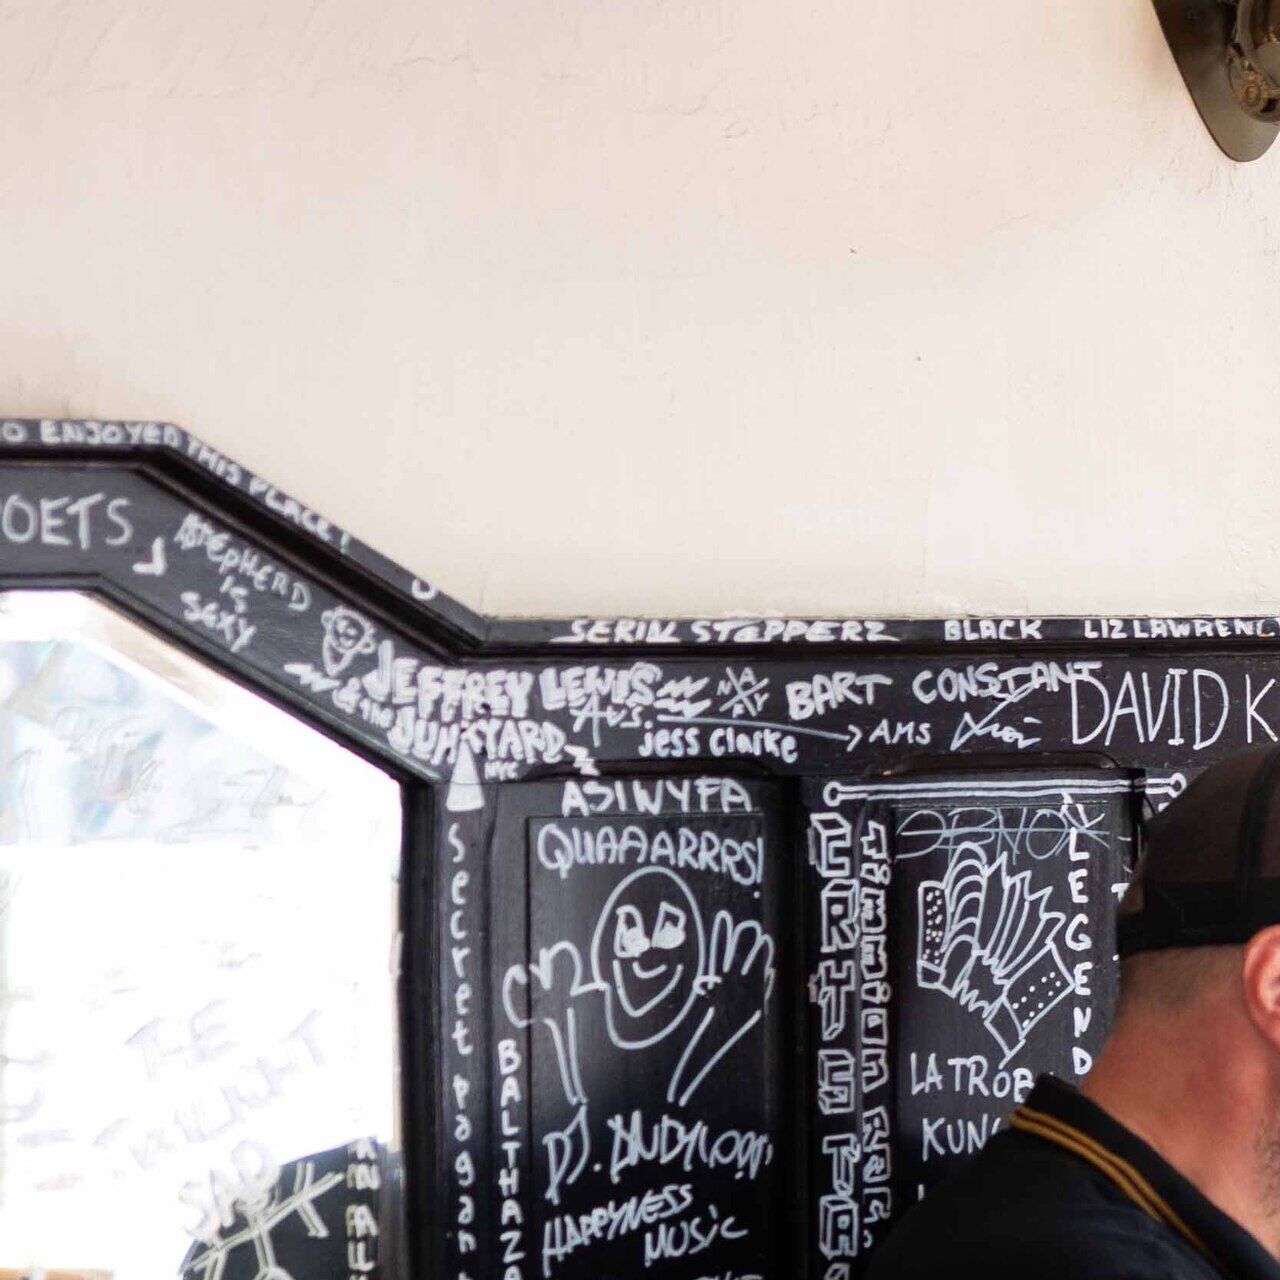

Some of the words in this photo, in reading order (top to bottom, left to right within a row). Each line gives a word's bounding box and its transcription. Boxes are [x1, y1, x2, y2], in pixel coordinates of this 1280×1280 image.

[40, 419, 184, 449] ENJOYED
[186, 435, 244, 487] THIS
[944, 619, 1043, 641] BLACK
[1084, 619, 1128, 639] LIZ
[361, 640, 534, 724] JEFFREY
[540, 661, 664, 711] LEWIS
[785, 672, 893, 721] BART
[911, 661, 1103, 704] CONSTANT
[1071, 667, 1230, 750] DAVID
[708, 727, 800, 764] Clarke
